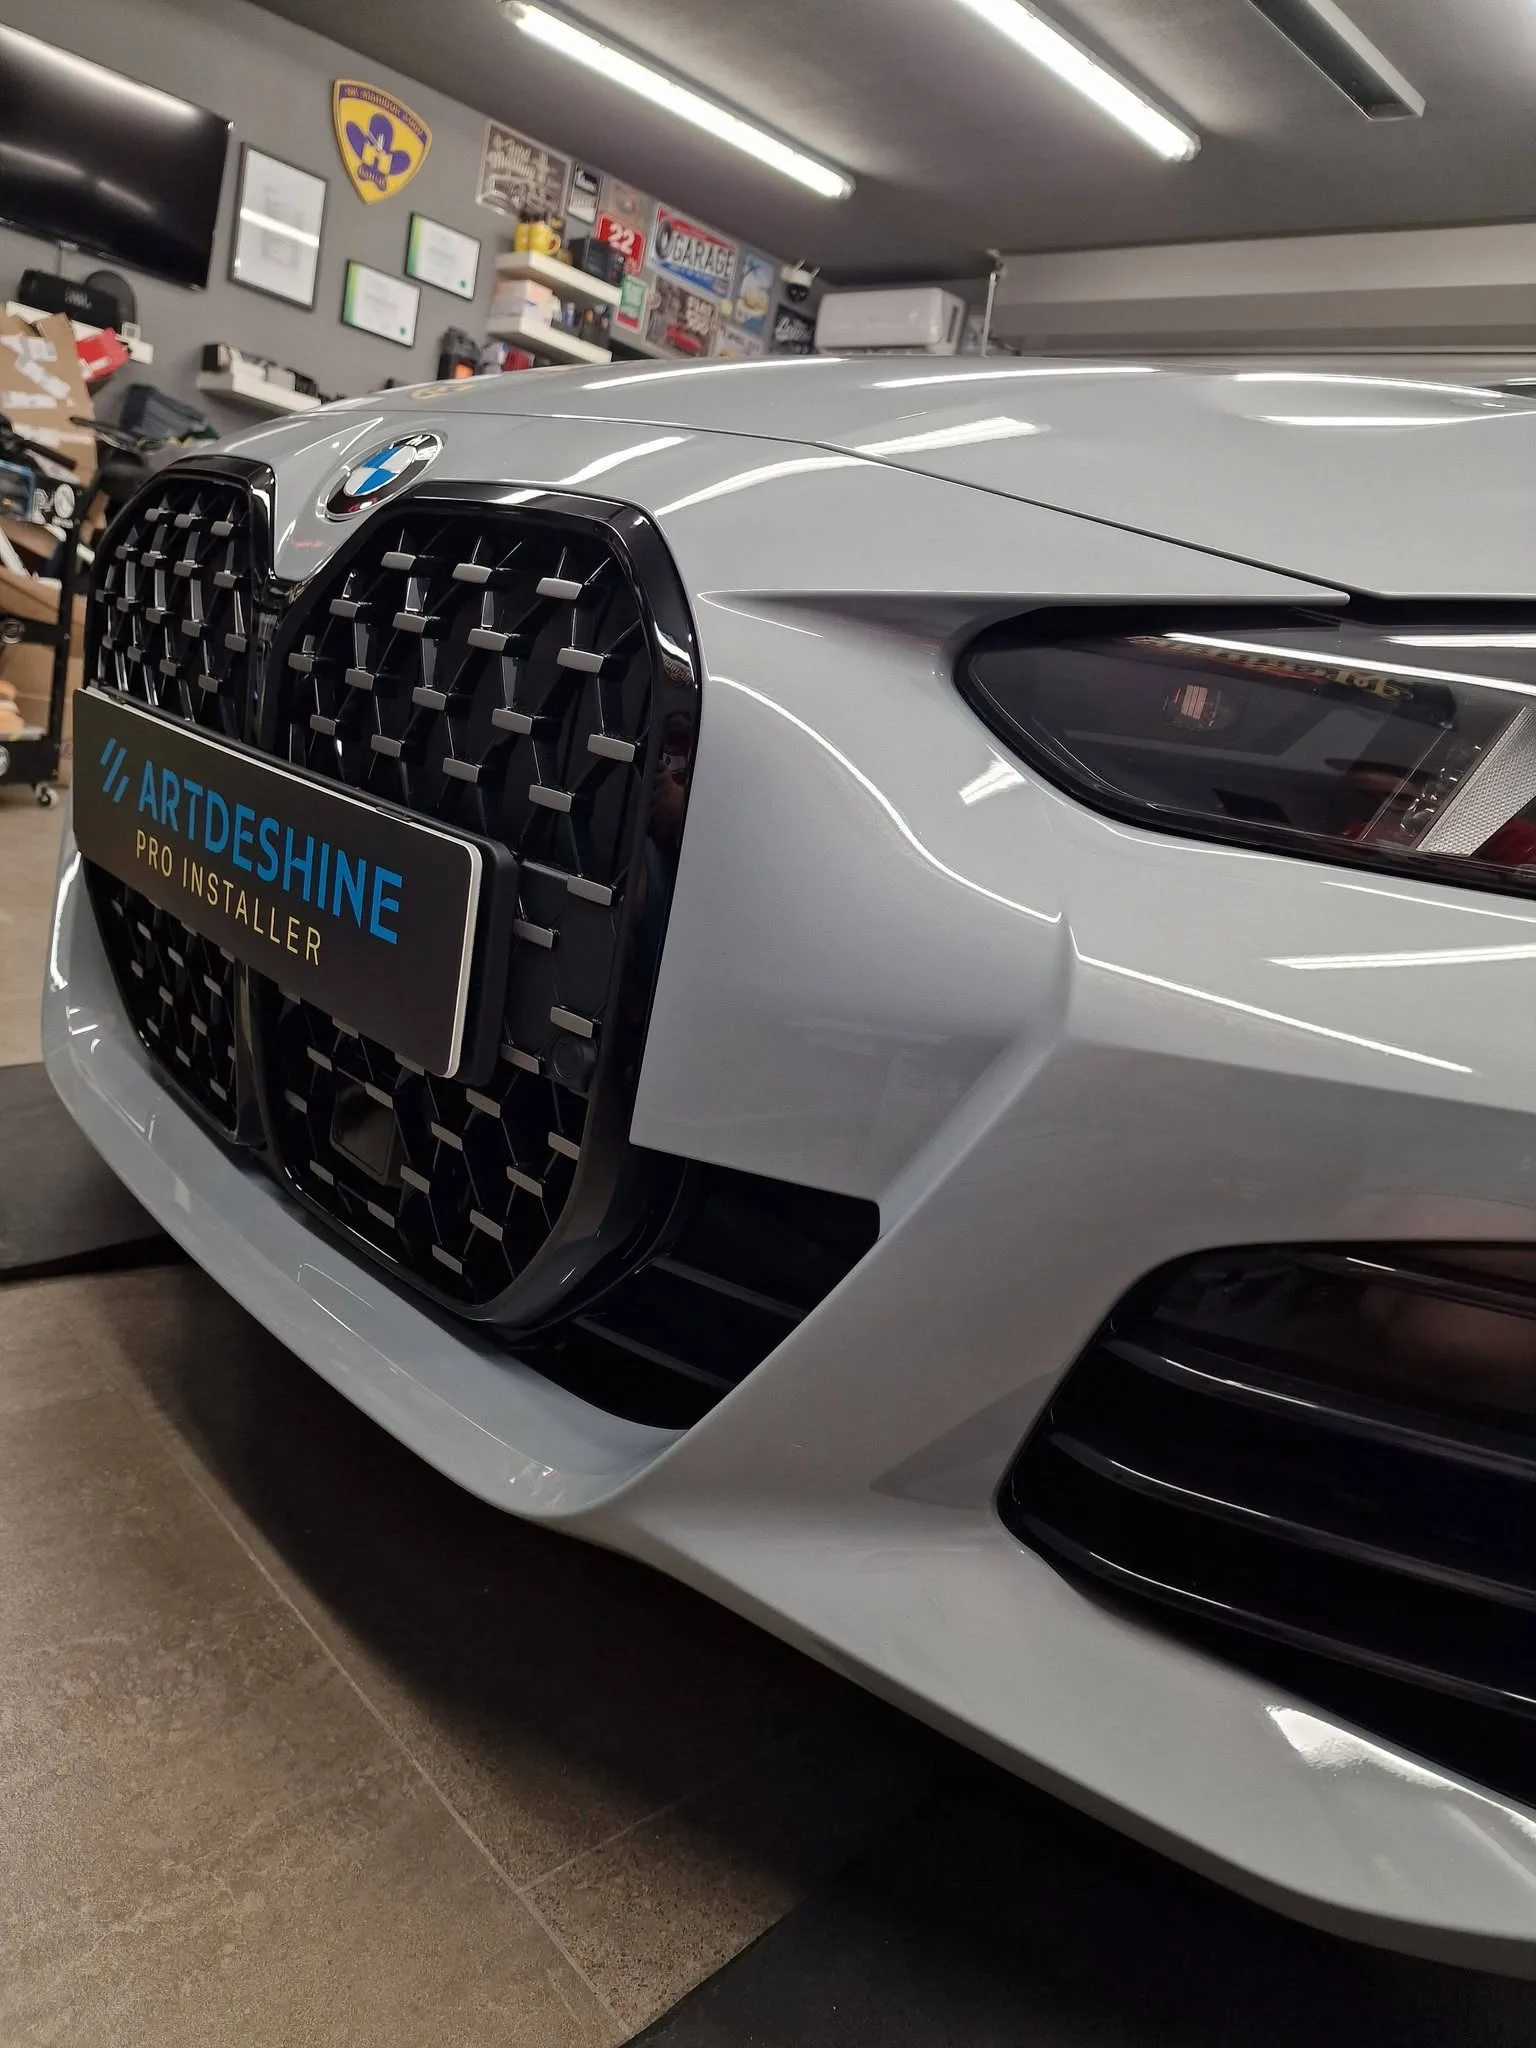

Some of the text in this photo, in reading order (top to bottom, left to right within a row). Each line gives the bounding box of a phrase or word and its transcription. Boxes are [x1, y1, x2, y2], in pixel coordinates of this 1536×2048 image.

[608, 223, 635, 255] 22
[671, 231, 735, 278] GARAGE
[136, 829, 321, 966] PRO INSTALLER
[138, 760, 403, 944] ARTDESHINE
